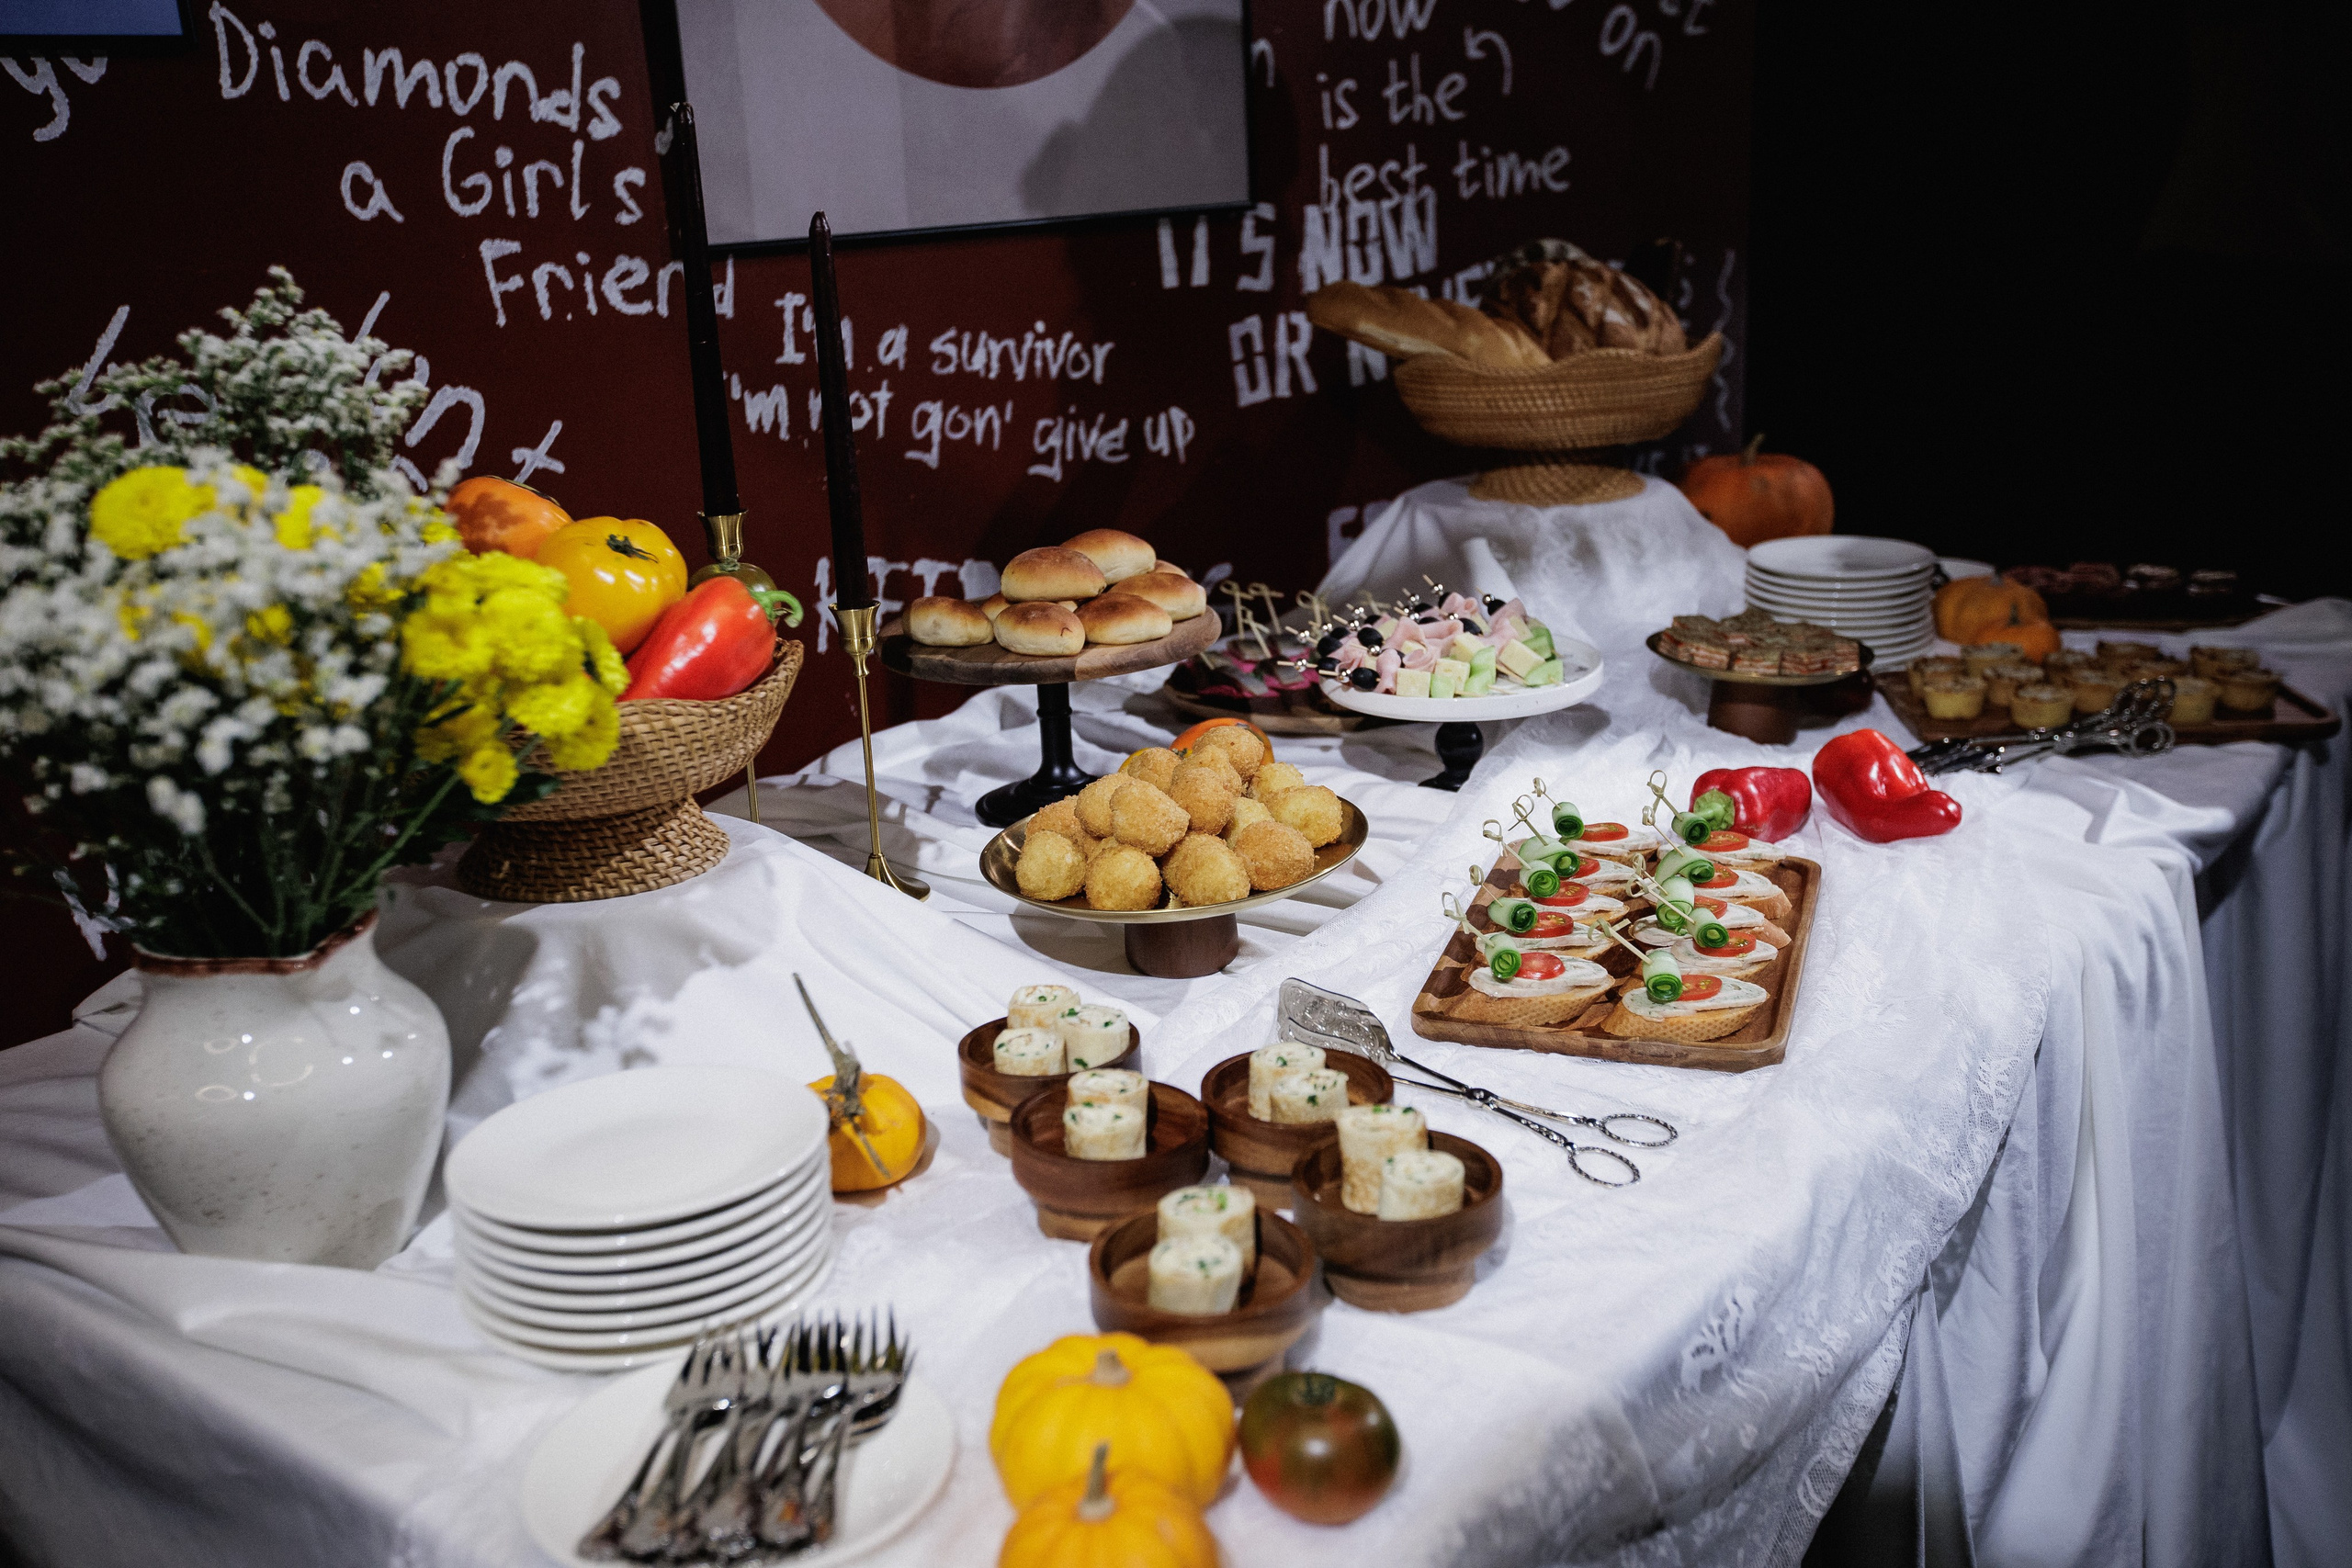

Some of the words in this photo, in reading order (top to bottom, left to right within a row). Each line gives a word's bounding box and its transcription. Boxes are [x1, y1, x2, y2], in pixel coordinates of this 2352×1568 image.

[208, 0, 623, 141] Diamonds
[1316, 72, 1360, 130] is
[1382, 51, 1468, 126] the
[340, 160, 405, 223] a
[1317, 142, 1429, 213] best
[1452, 139, 1572, 200] time
[1296, 186, 1439, 295] NOW
[876, 323, 909, 370] a
[929, 319, 1115, 385] survivor
[1227, 310, 1318, 408] OR
[904, 399, 1014, 469] gon'
[1026, 404, 1131, 483] give
[1142, 404, 1195, 463] up
